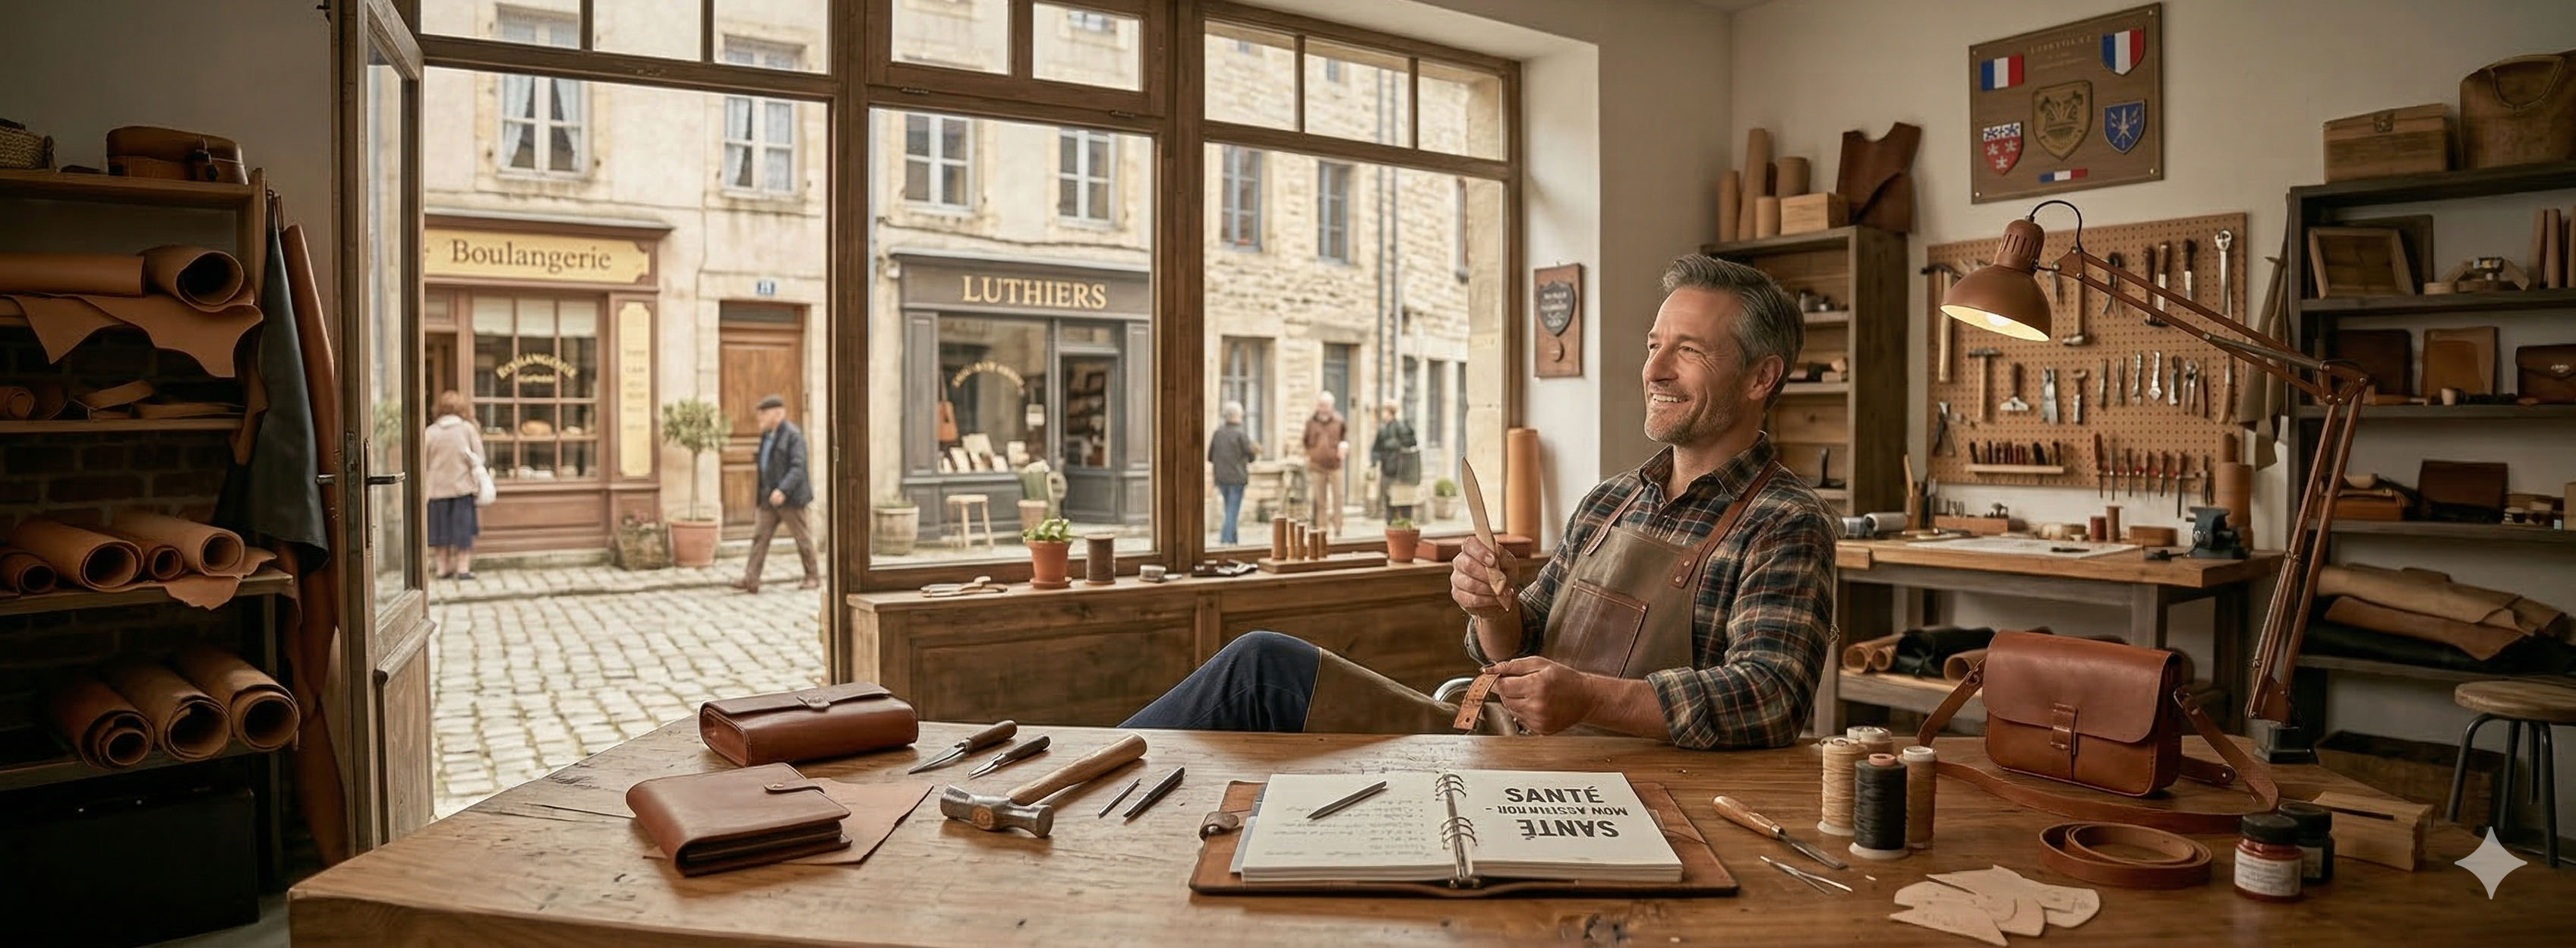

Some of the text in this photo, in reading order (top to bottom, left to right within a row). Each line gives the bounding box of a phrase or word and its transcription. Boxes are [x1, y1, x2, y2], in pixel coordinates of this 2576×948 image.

[451, 239, 611, 274] Boulangerie
[961, 275, 1107, 309] LUTHIERS
[1504, 786, 1605, 803] SANTÉ
[1516, 820, 1619, 840] SANTÉ
